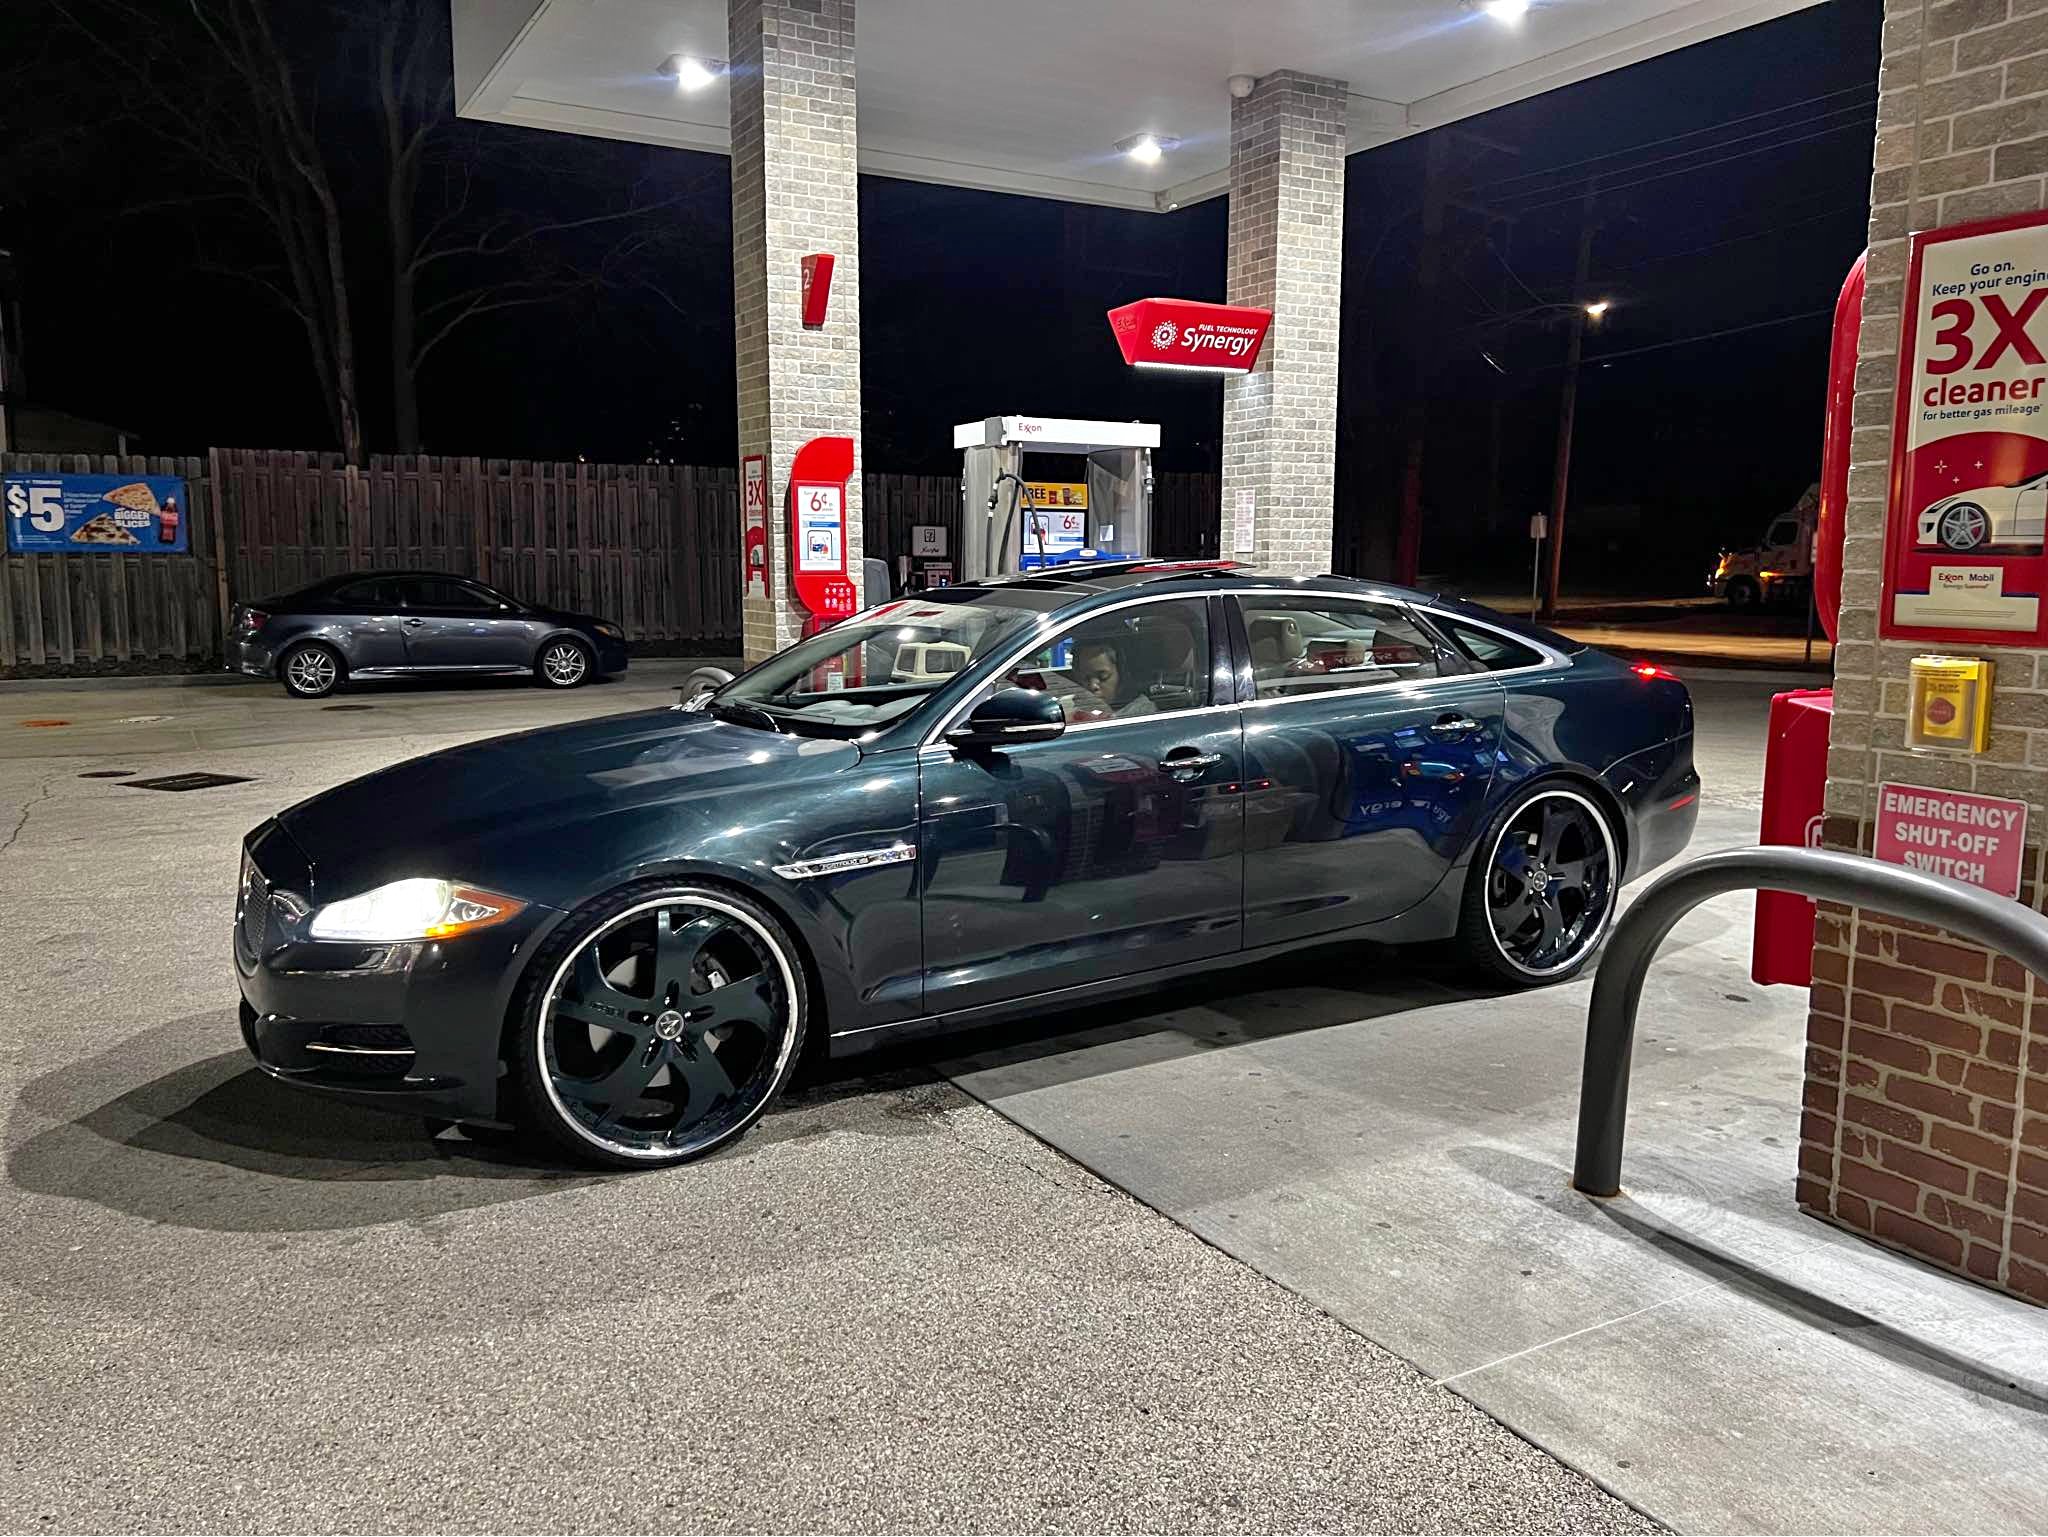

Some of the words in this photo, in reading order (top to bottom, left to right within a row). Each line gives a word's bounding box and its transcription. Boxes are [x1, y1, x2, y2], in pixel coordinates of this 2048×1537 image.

[803, 268, 810, 290] 2
[1970, 263, 1990, 276] Go
[1993, 261, 2015, 273] on.
[1932, 283, 1966, 296] Keep
[1970, 277, 2002, 294] your
[2005, 269, 2048, 287] engin
[1181, 327, 1255, 356] Synergy
[1198, 323, 1214, 332] FUEL
[1216, 324, 1259, 335] TECHNOLOGY
[1925, 287, 2048, 376] 3X
[1923, 377, 2046, 407] cleaner
[1923, 411, 1938, 421] for
[1940, 409, 1972, 419] better
[1974, 408, 1992, 419] gas
[1018, 422, 1042, 434] Exxon
[748, 480, 763, 505] 3X
[7, 484, 65, 532] $5
[114, 510, 150, 520] BIGGER
[1938, 572, 1964, 583] Exxon
[1969, 573, 1994, 582] Mobil
[1884, 792, 2018, 831] EMERGENCY
[1895, 822, 2000, 856] SHUT-OFF
[1903, 851, 1985, 883] SWITCH
